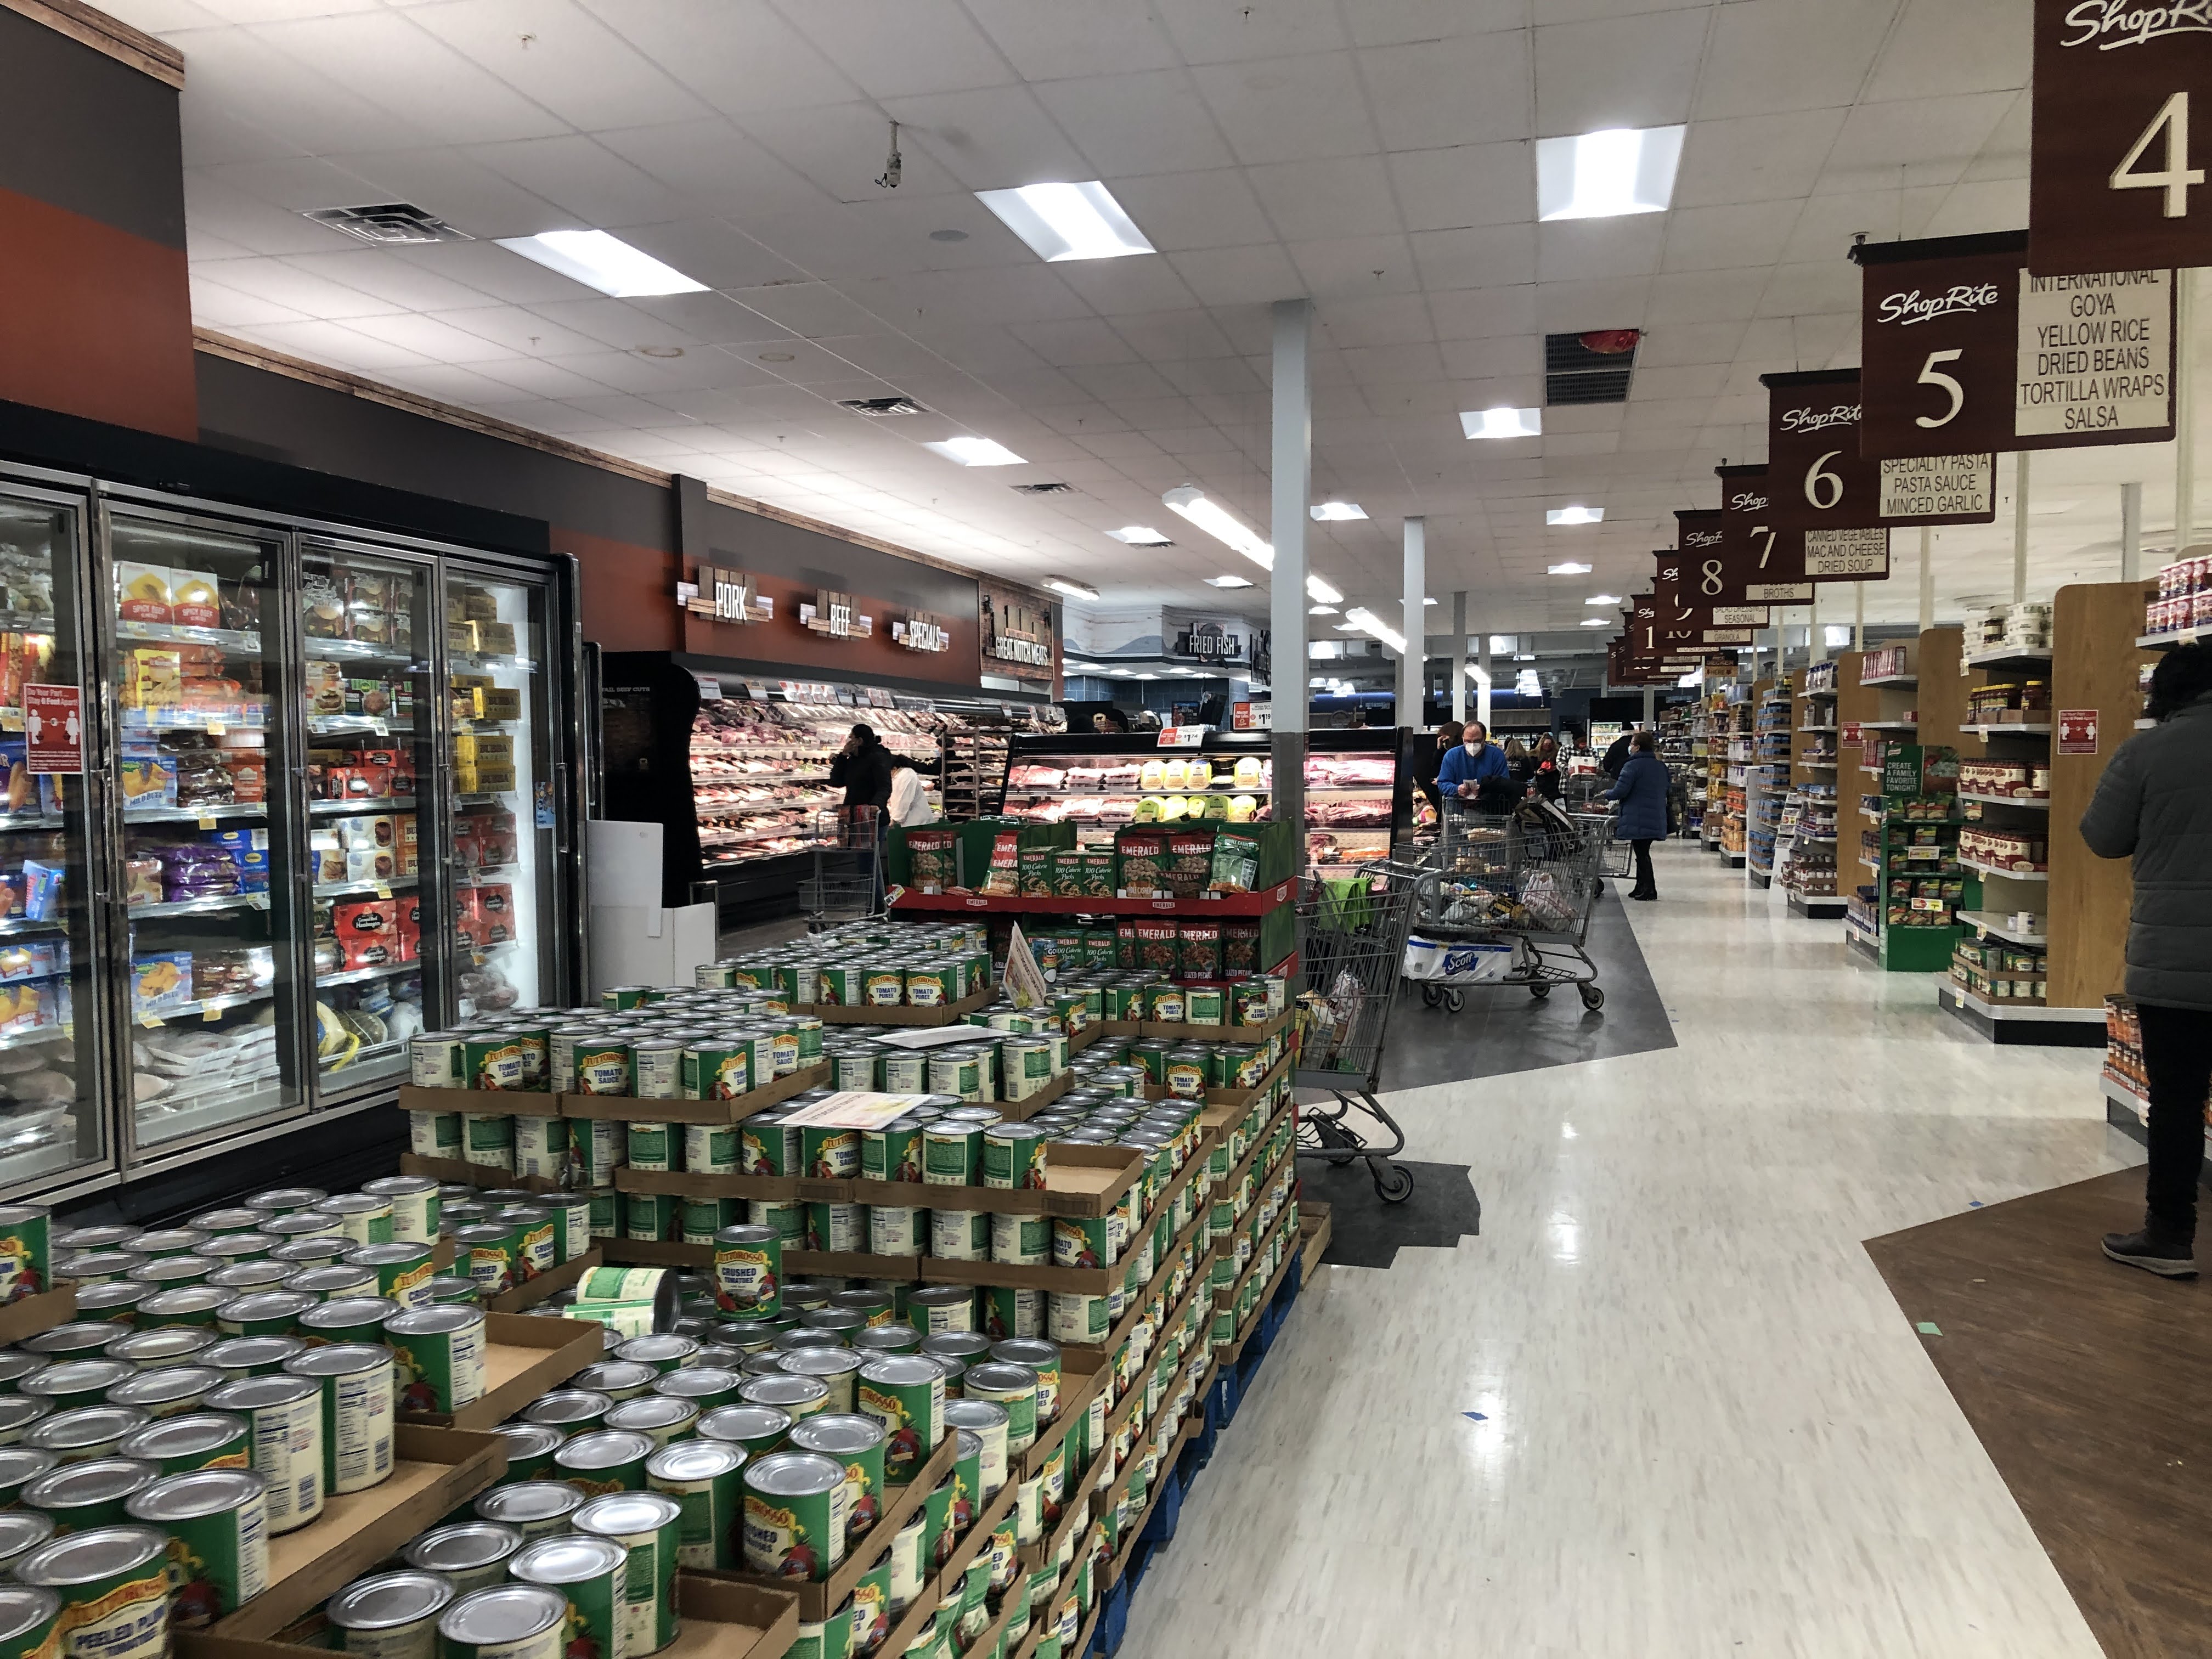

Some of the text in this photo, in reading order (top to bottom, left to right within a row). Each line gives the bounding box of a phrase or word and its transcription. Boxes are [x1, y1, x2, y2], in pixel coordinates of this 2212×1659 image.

[2061, 0, 2212, 50] ShopR
[2108, 92, 2205, 218] 4
[2030, 269, 2159, 292] INTERNATIONAL
[1877, 283, 1999, 325] ShopRite
[2071, 294, 2115, 317] GOYA
[2038, 318, 2150, 348] YELLOW RICE
[2038, 347, 2149, 376] DRIED BEANS
[1915, 349, 1964, 428] 5
[2021, 374, 2164, 404] TORTILLA WRAPS
[2064, 406, 2119, 429] SALSA
[1883, 454, 1989, 474] SPECIALTY PASTA
[1804, 451, 1843, 509] 6
[1894, 474, 1976, 493] PASTA SAUCE
[1730, 492, 1769, 512] Shop
[1887, 494, 1983, 515] MINCED GARLIC
[1807, 528, 1884, 543] CANNED VEGETABLES
[1750, 526, 1777, 568] 7
[1807, 543, 1885, 557] MAC AND CHEESE
[1818, 559, 1873, 573] DRIED SOUP
[1702, 560, 1723, 595] 8
[715, 582, 747, 620] PORK
[1764, 588, 1795, 599] BROTHS
[830, 604, 850, 636] BEEF
[1724, 614, 1756, 623] SEASONAL
[909, 620, 941, 652] SPECIALS
[1189, 635, 1234, 654] FRIED FISH
[1646, 626, 1655, 648] 1
[996, 636, 1014, 660] GREAT
[1031, 642, 1048, 666] MEATS
[909, 840, 940, 851] EMERALD
[997, 844, 1017, 852] EMER
[1121, 845, 1159, 856] EMERALD
[1172, 844, 1211, 855] EMERALD
[993, 859, 1018, 868] EMERA
[1138, 928, 1176, 940] EMERALD
[1180, 930, 1217, 943] EMERALD
[1222, 928, 1259, 939] EMERALD
[1448, 953, 1474, 970] Scott
[870, 975, 901, 985] TUTTOROSSO
[907, 977, 942, 985] TUTTOROSSO
[1198, 971, 1212, 979] PECANS
[773, 1050, 795, 1059] TOMATO
[594, 1068, 623, 1077] TOMATO
[599, 1076, 619, 1084] SAUCE
[1169, 1065, 1200, 1076] TUTTOROSSO
[722, 1267, 756, 1276] CRUSHED
